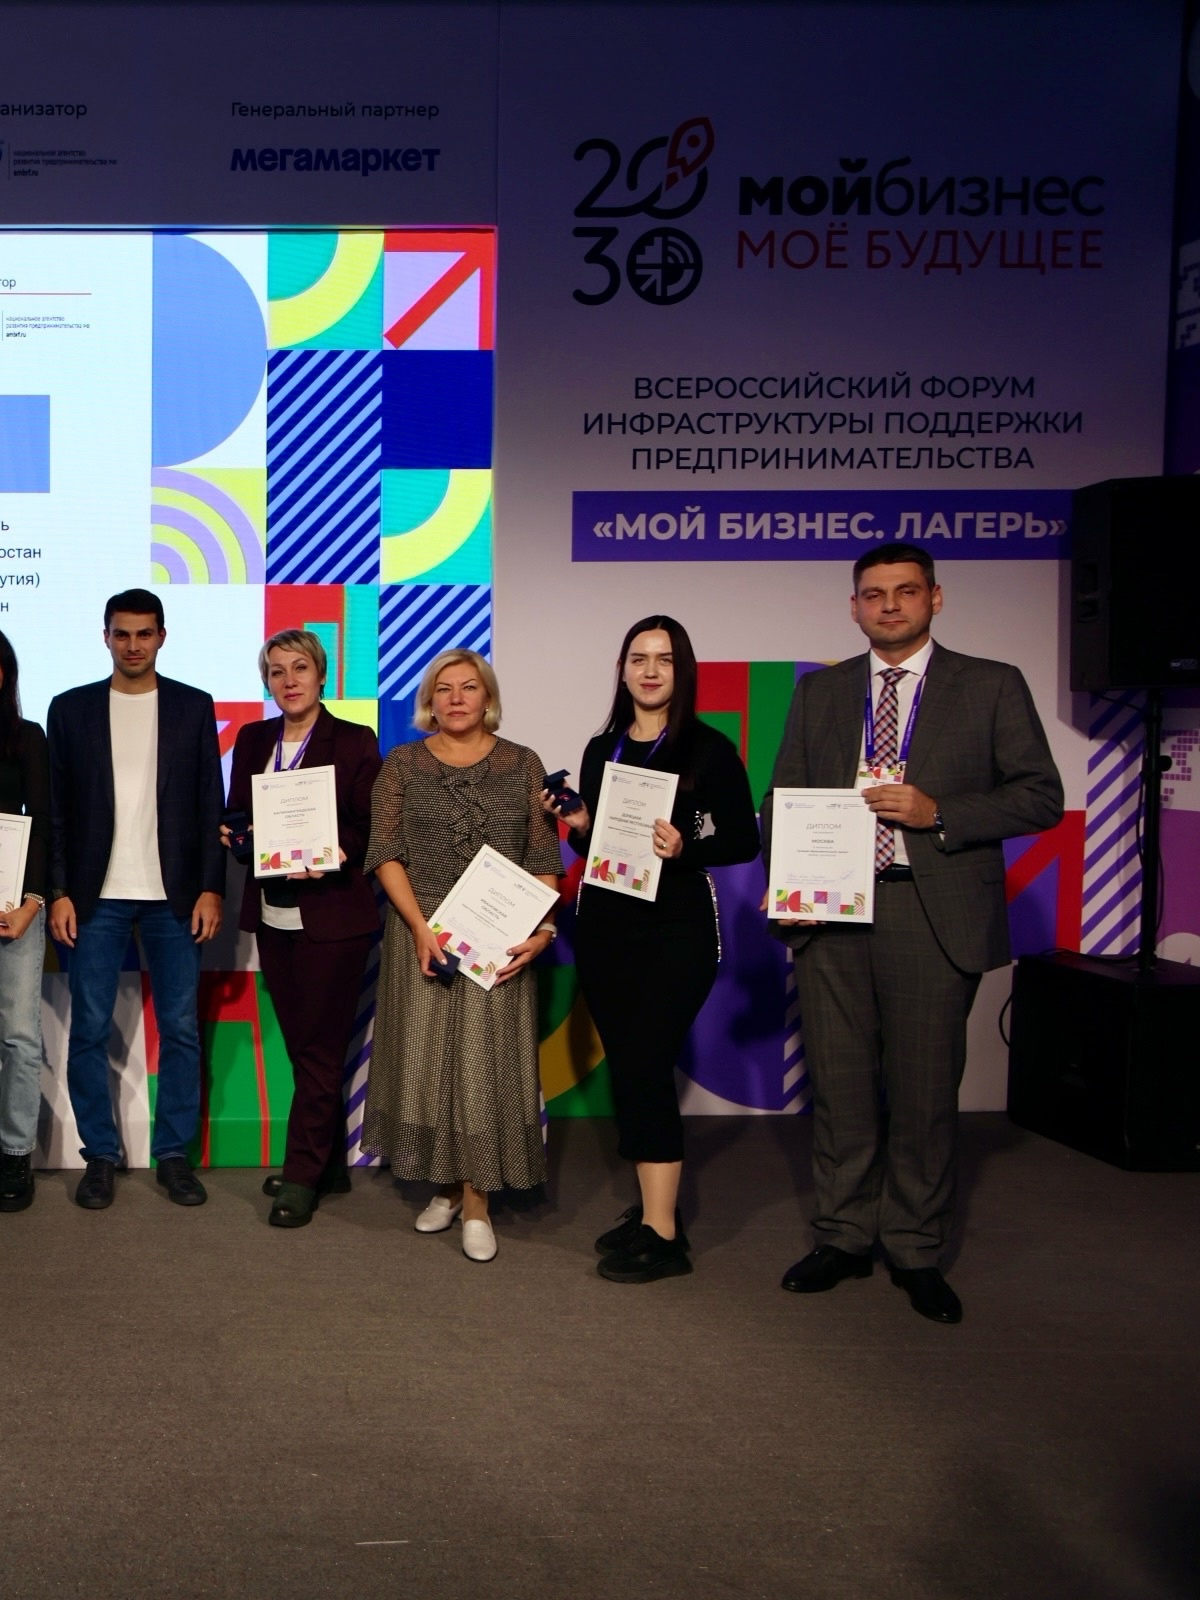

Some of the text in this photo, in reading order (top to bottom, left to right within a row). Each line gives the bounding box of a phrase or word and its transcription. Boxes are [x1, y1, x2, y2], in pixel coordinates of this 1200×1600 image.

[232, 102, 439, 119] Генеральный партнер
[230, 147, 440, 176] мегамаркет
[738, 222, 1104, 275] МОЁ БУДУЩЕЕ
[635, 371, 1035, 399] ВСЕРОССИЙСКИЙ ФОРУМ
[584, 411, 1083, 438] ИНФРАСТРУКТУРЫ ПОДДЕРЖКИ
[632, 447, 1035, 474] ПРЕДПРИНИМАТЕЛЬСТВА
[593, 506, 1068, 540] «МОЙ БИЗНЕС. ЛАГЕРЬ»
[280, 796, 308, 804] ДИПЛОМ
